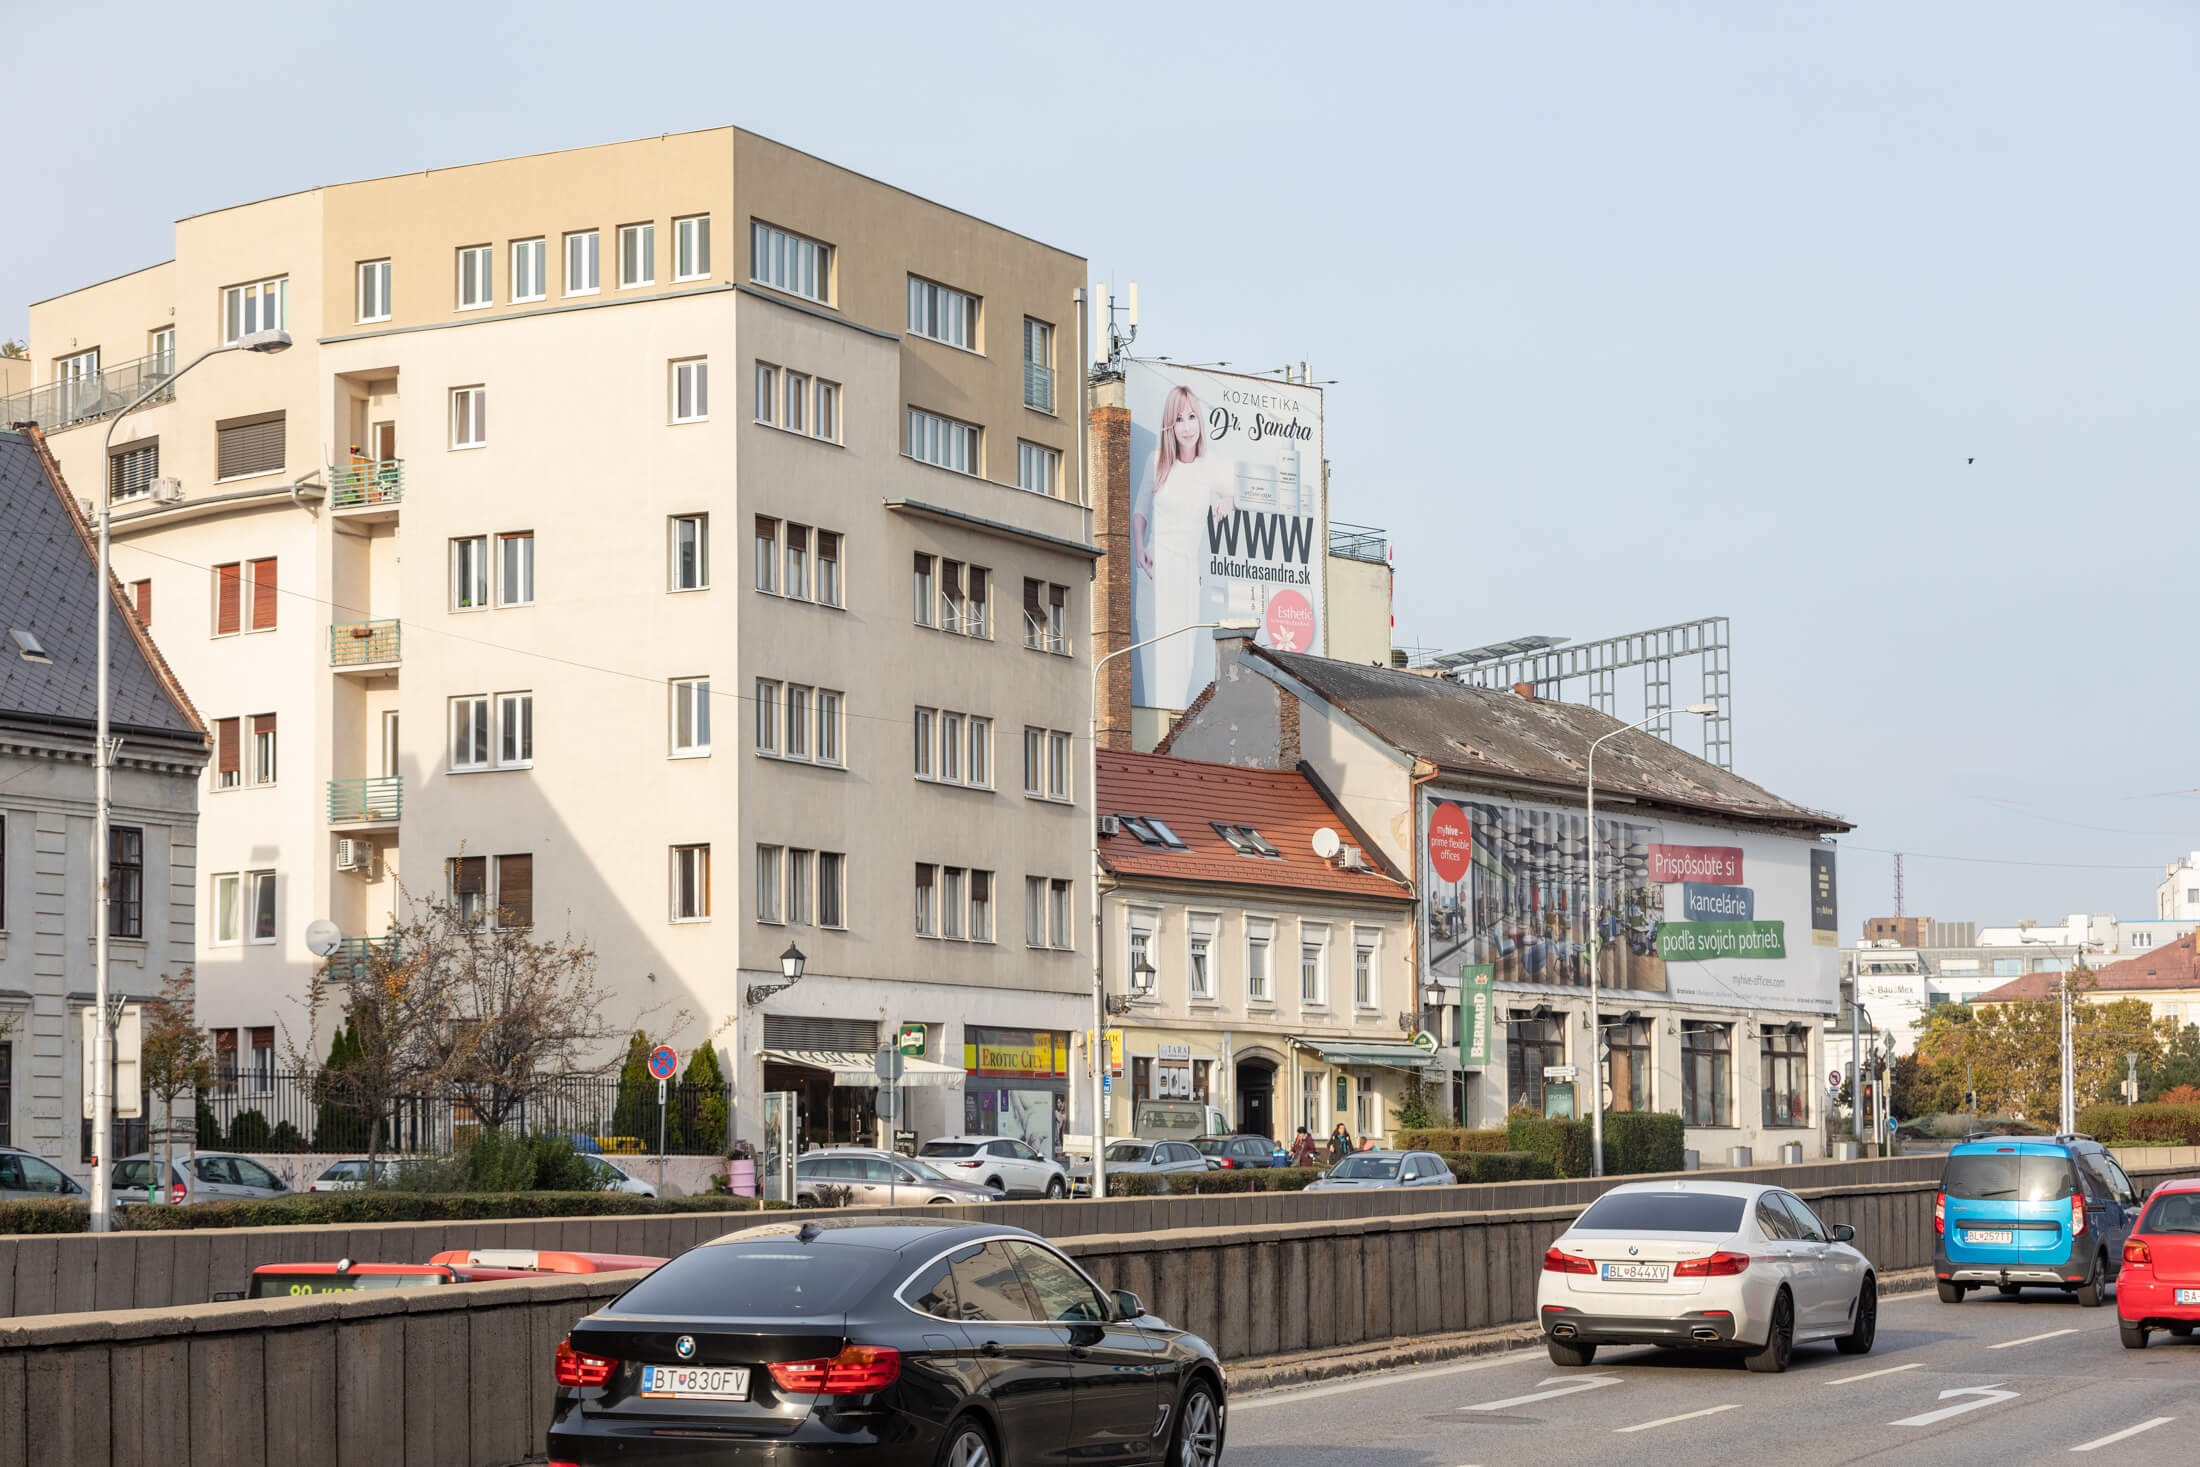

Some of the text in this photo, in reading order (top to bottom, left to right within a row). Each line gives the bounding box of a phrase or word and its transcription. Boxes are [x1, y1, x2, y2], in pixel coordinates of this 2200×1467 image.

[1223, 390, 1300, 412] KOZMETIKA
[1209, 406, 1313, 441] Dr. Sandra
[1210, 555, 1311, 585] doktorkasandra.sk
[1277, 605, 1313, 621] Esthetic
[1436, 824, 1459, 837] myhive
[1431, 838, 1470, 850] prime flexible
[1440, 850, 1461, 862] offices
[1655, 853, 1735, 879] Prispôsobte si
[1690, 888, 1746, 915] kancelárie
[1663, 927, 1780, 956] podľa svojich potrieb.
[1471, 992, 1486, 1057] BERNARD
[1168, 1045, 1187, 1055] TARA
